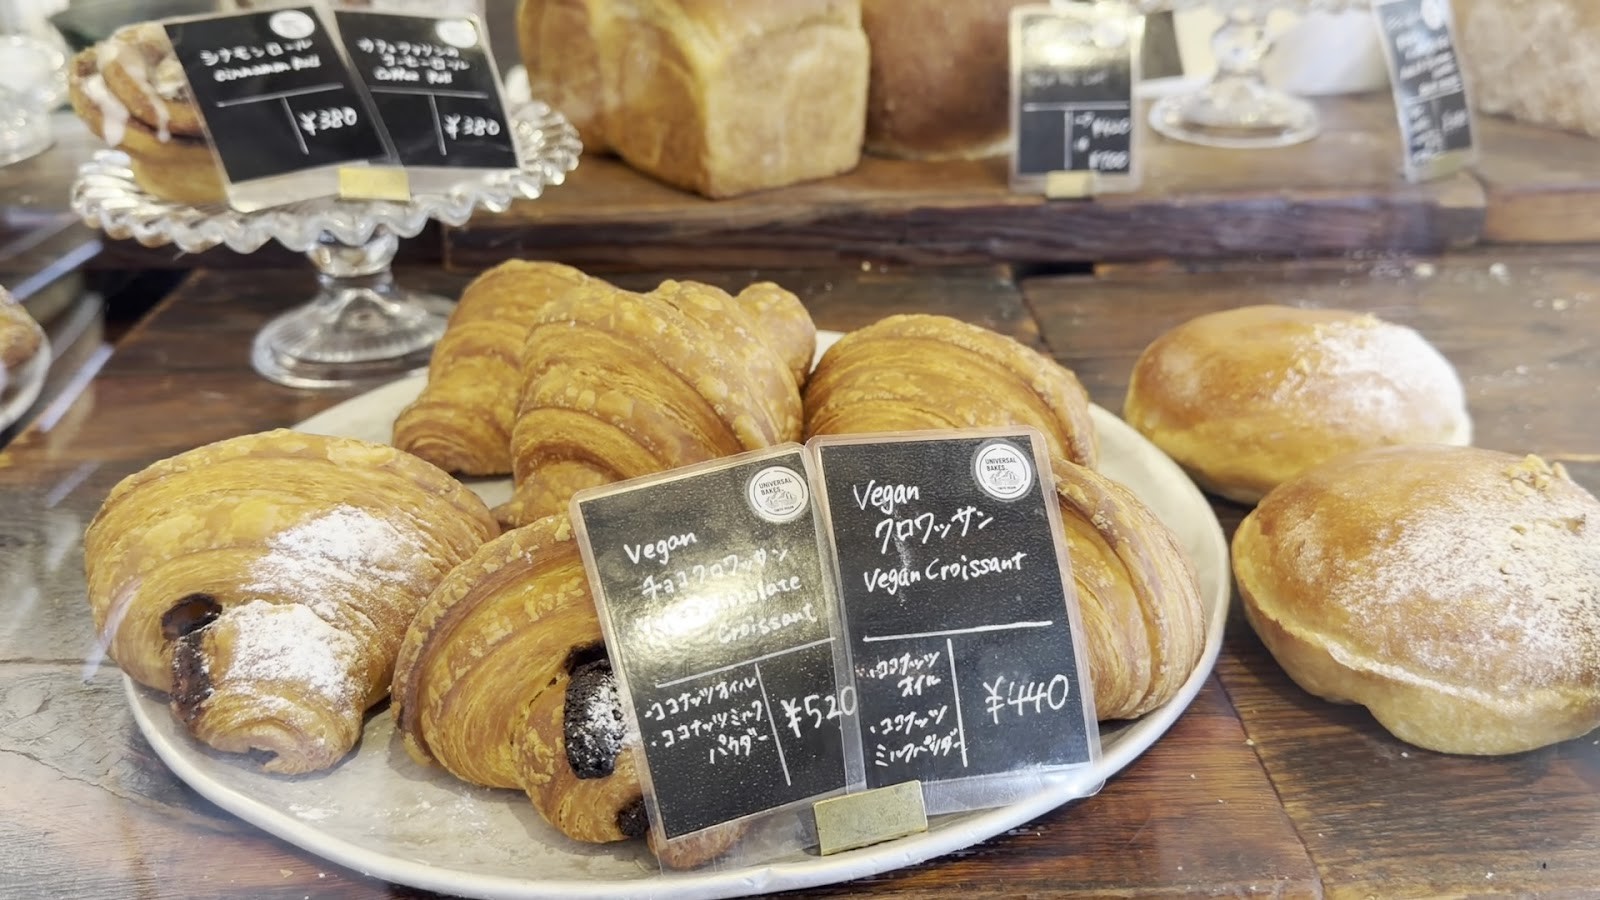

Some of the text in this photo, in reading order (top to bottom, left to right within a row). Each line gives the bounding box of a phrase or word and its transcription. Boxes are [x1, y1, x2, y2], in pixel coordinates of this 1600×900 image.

[200, 39, 314, 67] シナモンロール
[298, 106, 358, 137] ¥380
[444, 113, 500, 140] ¥380
[985, 457, 1017, 465] UNIVERSAL
[759, 477, 792, 489] UNIVERSAL
[853, 479, 920, 516] Vegan
[875, 505, 994, 555] クロワッサン
[863, 551, 1028, 596] Vegan Croissant
[897, 673, 942, 698] オイル
[983, 673, 1069, 725] ¥440
[780, 685, 858, 739] ¥520
[709, 727, 769, 765] パウダー
